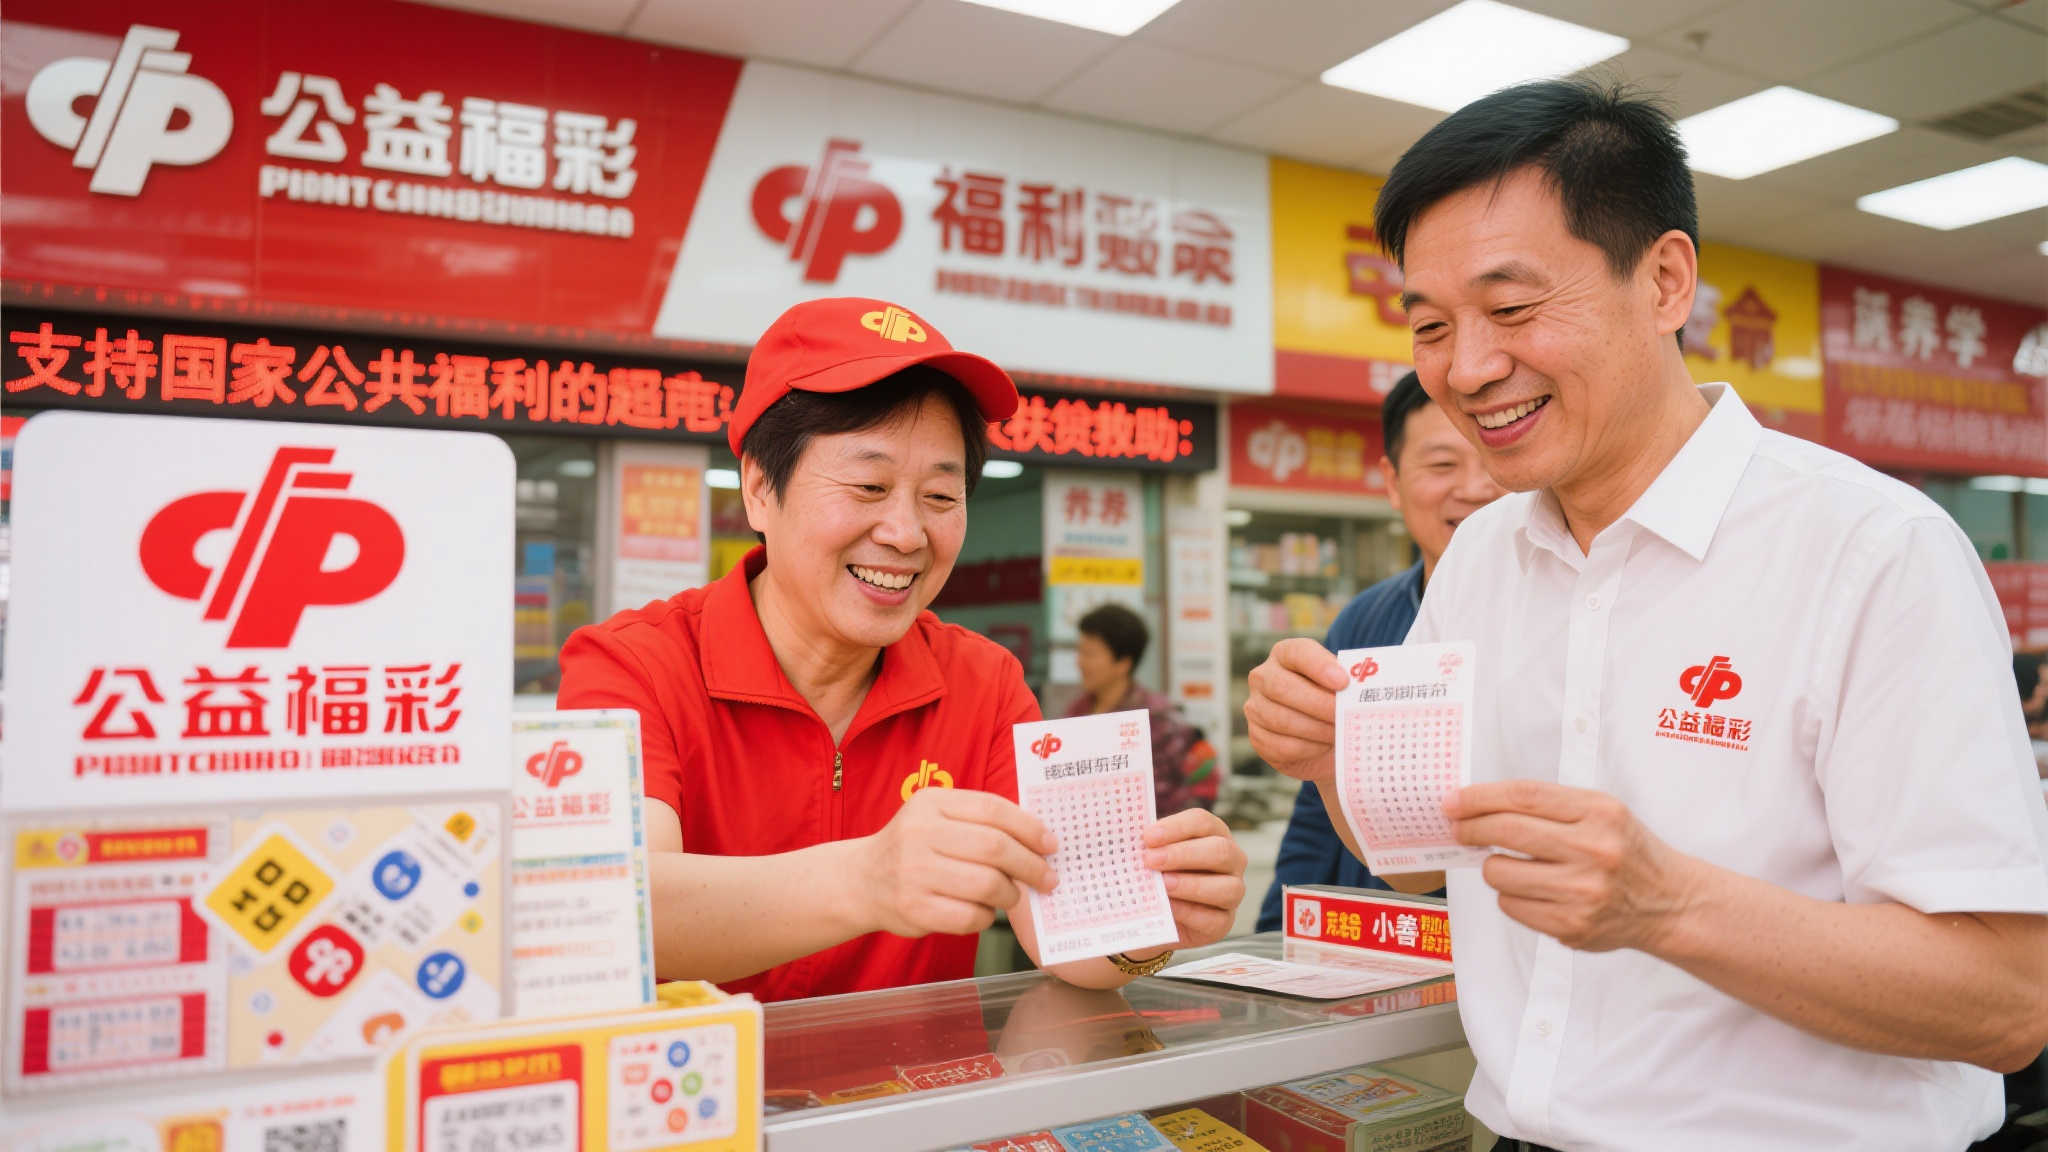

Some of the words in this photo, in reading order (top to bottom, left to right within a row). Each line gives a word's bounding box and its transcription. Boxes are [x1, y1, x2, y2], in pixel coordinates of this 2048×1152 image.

[260, 71, 638, 199] 公益福彩
[73, 664, 462, 740] 公益福彩
[1658, 708, 1752, 742] 公益福彩
